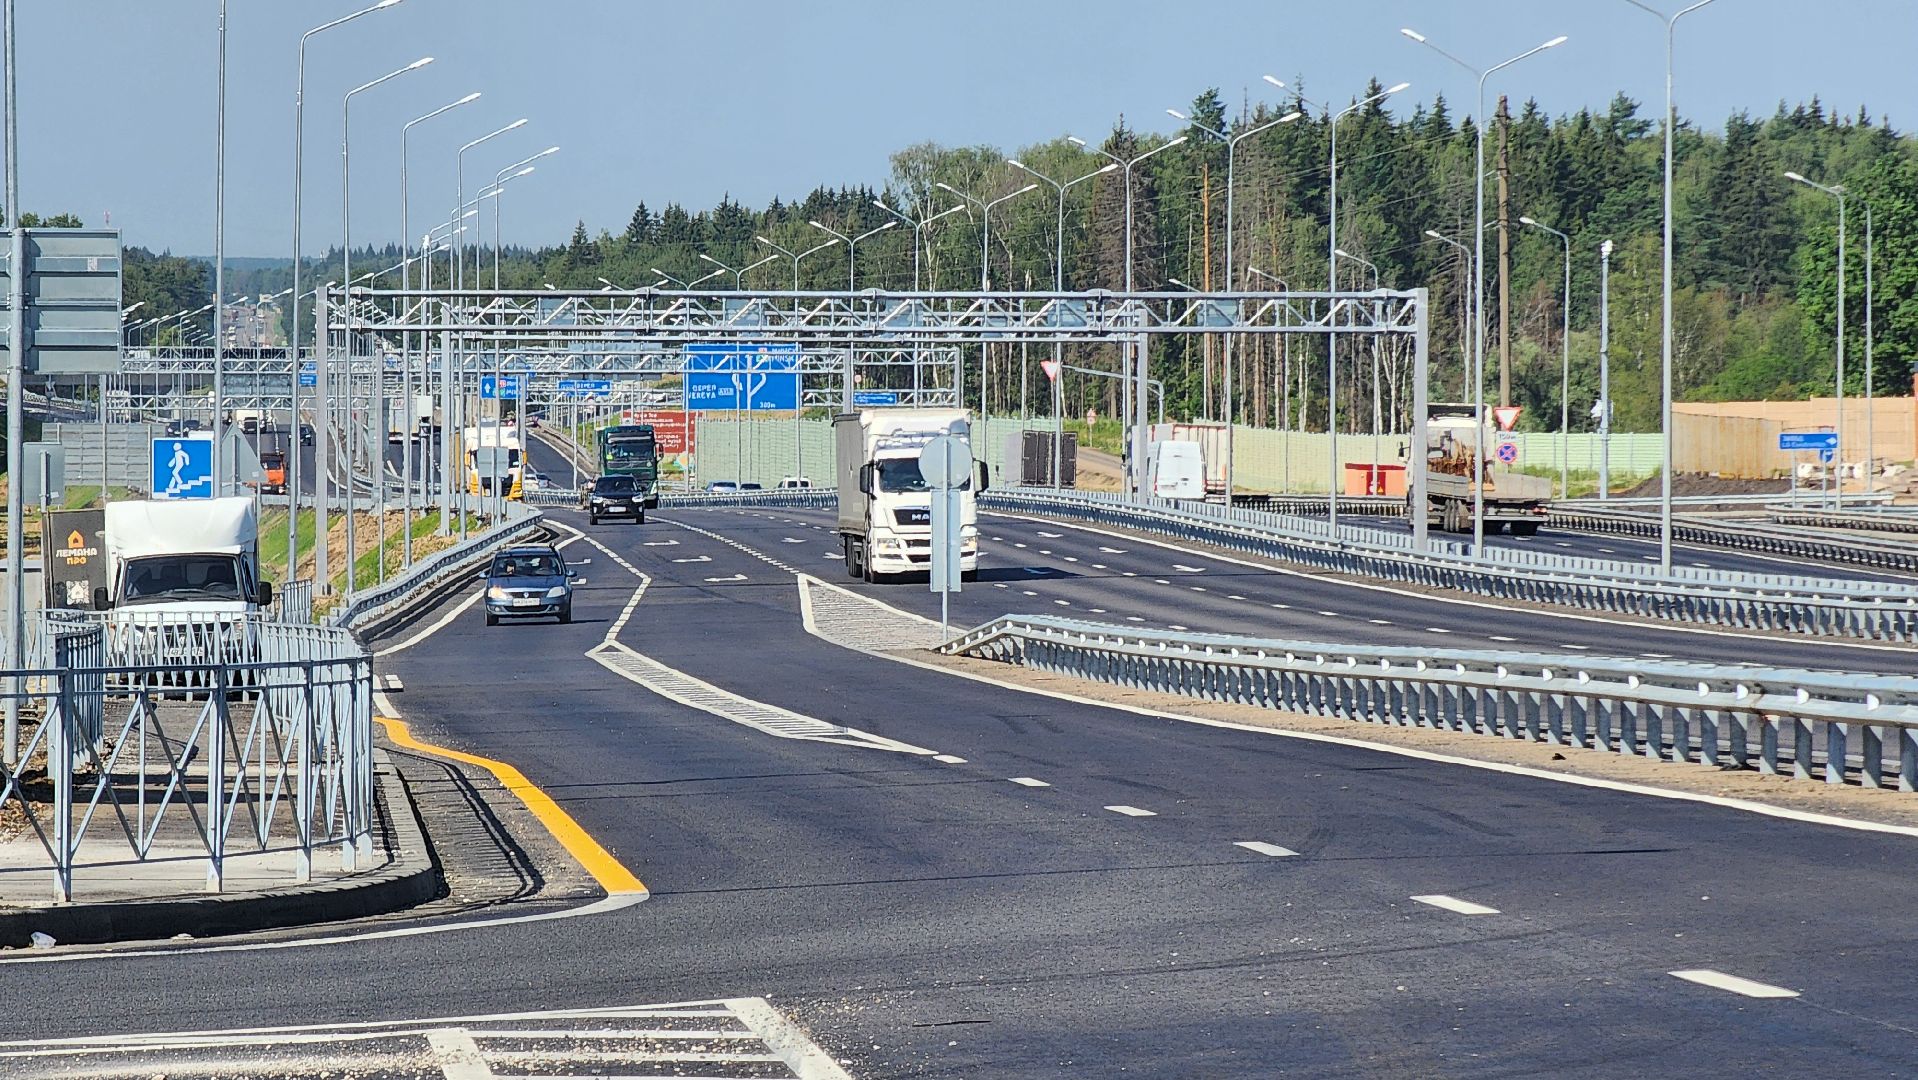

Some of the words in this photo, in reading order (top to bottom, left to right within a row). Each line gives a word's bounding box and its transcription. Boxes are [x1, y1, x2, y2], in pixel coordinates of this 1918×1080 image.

[911, 512, 930, 521] MA
[55, 547, 98, 558] ЛЕМАНА
[66, 556, 87, 565] ПРО
